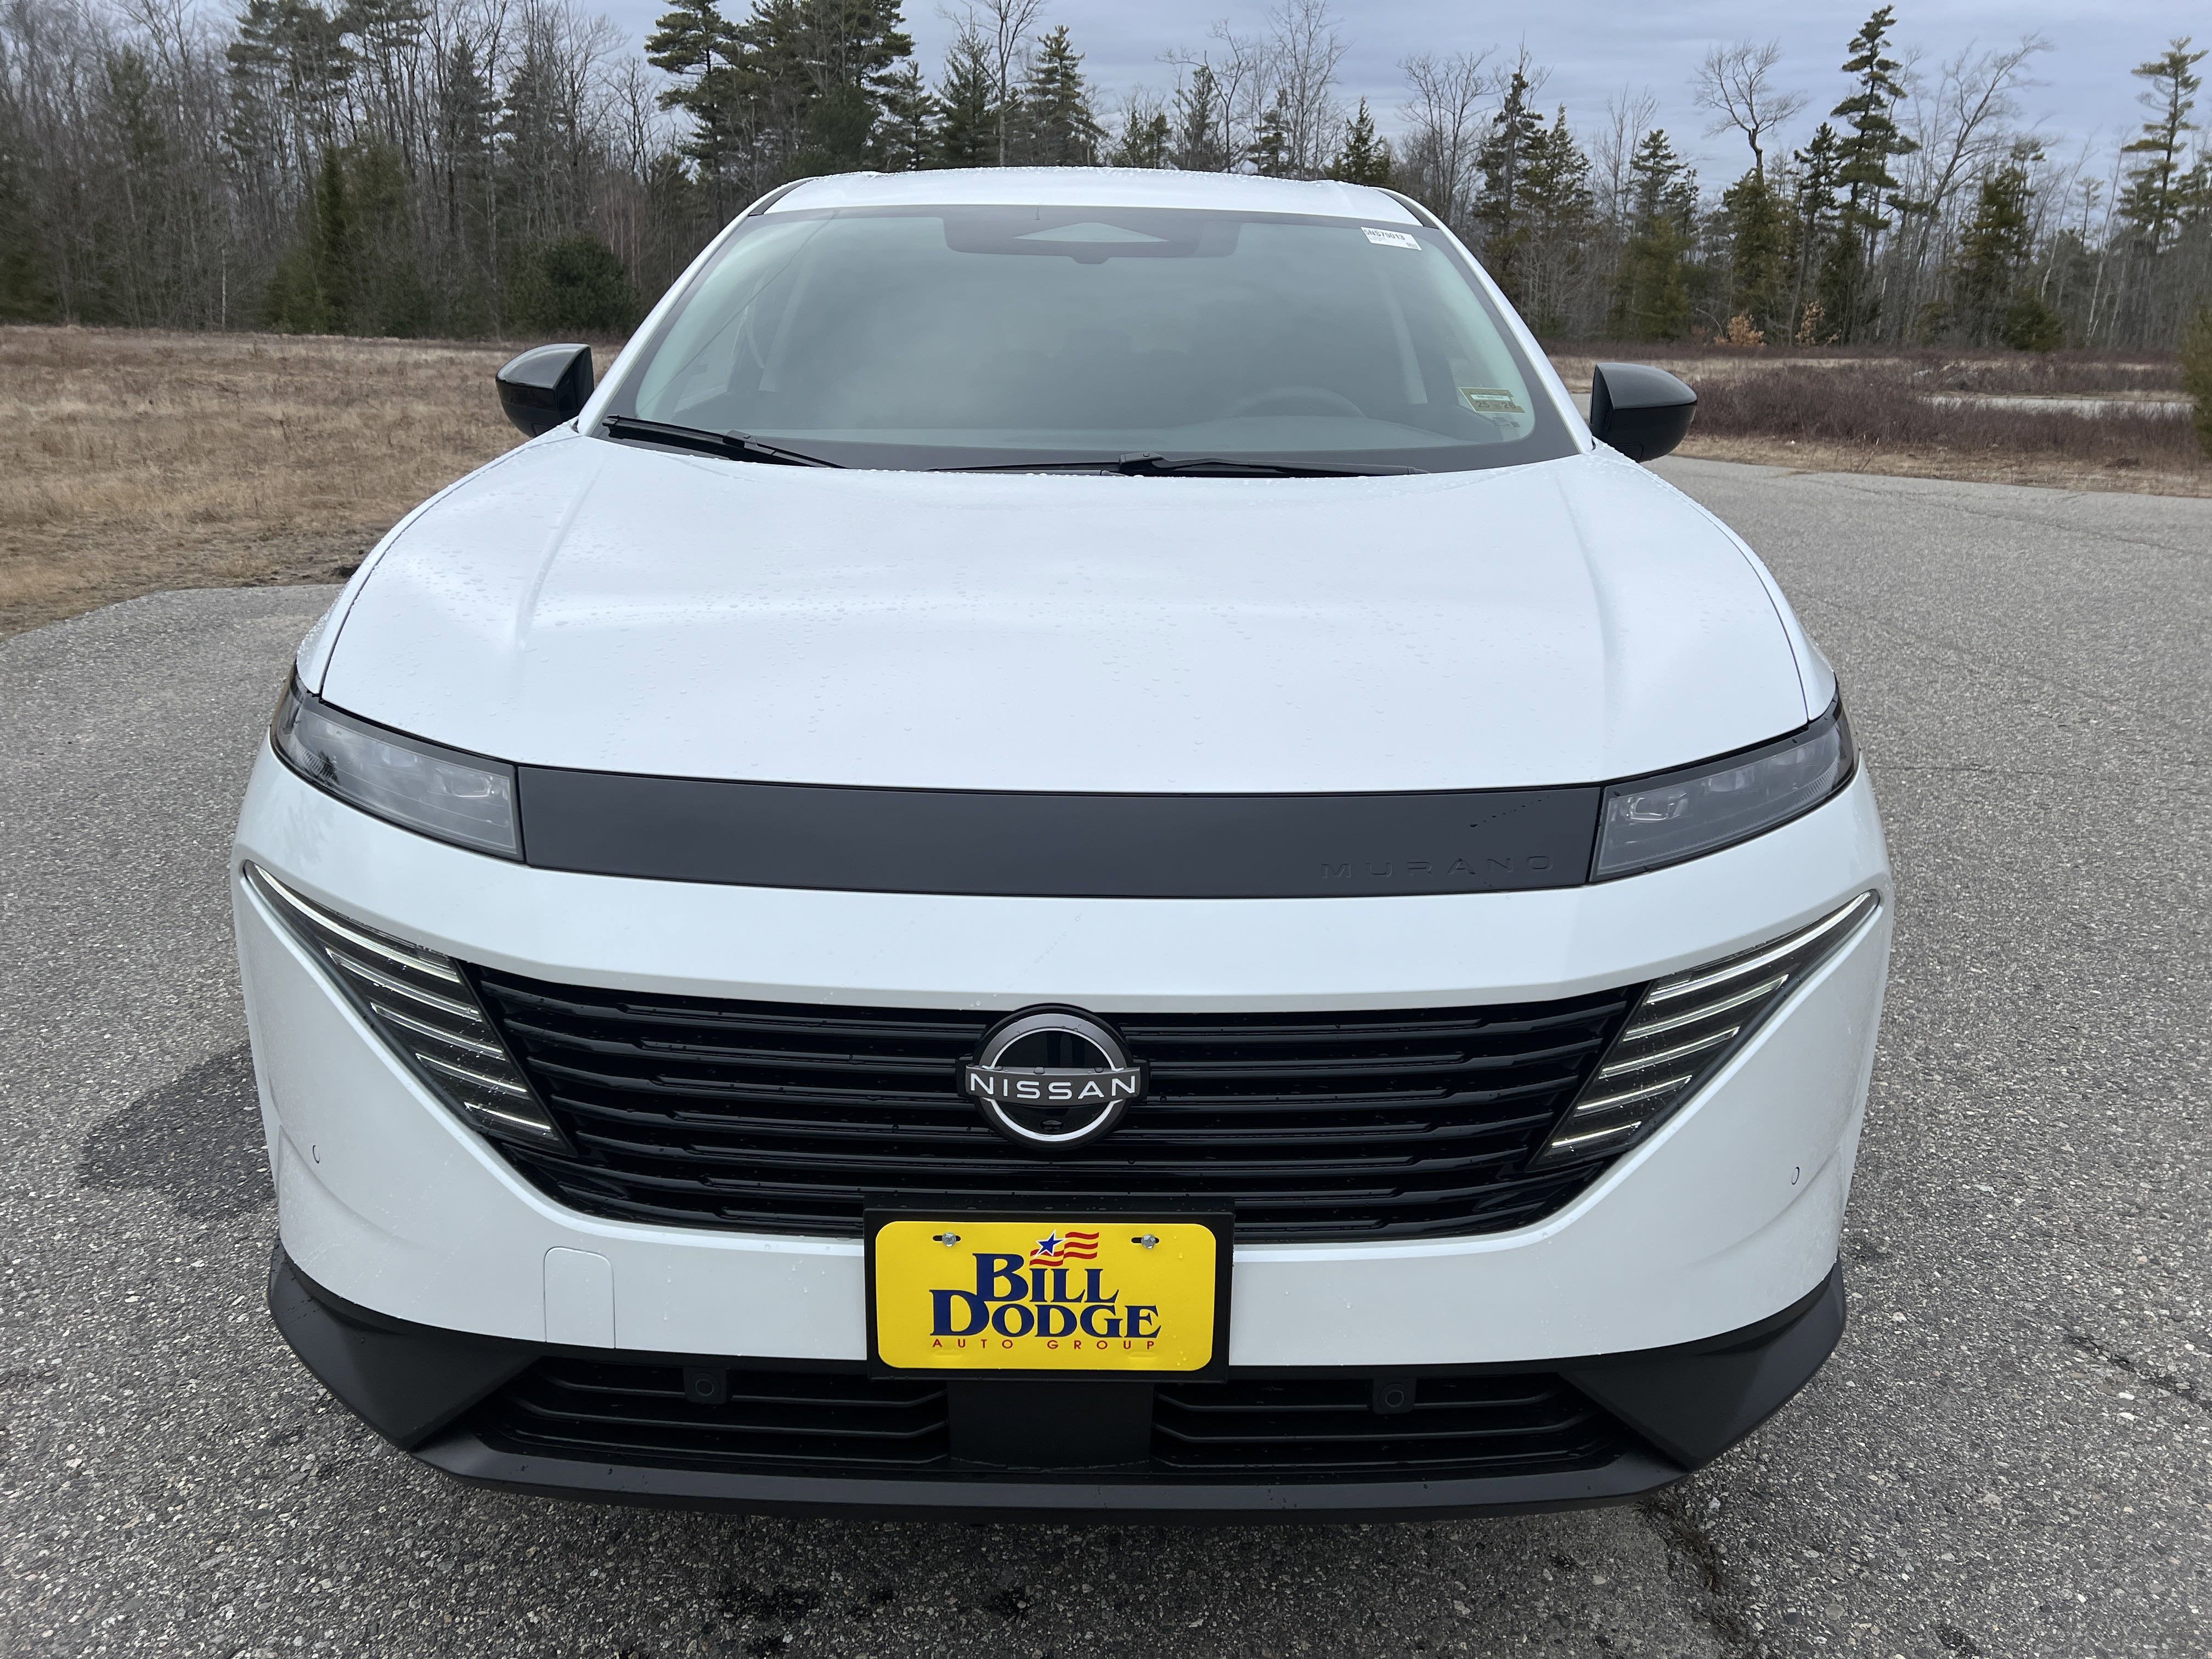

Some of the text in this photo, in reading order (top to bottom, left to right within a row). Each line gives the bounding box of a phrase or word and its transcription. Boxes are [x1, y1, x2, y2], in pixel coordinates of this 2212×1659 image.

[1321, 856, 1554, 878] MURANO
[970, 1073, 1136, 1100] NISSAN
[972, 1253, 1119, 1303] BILL
[929, 1289, 1162, 1338] DODGE
[932, 1339, 1155, 1350] AUTO GROUP
